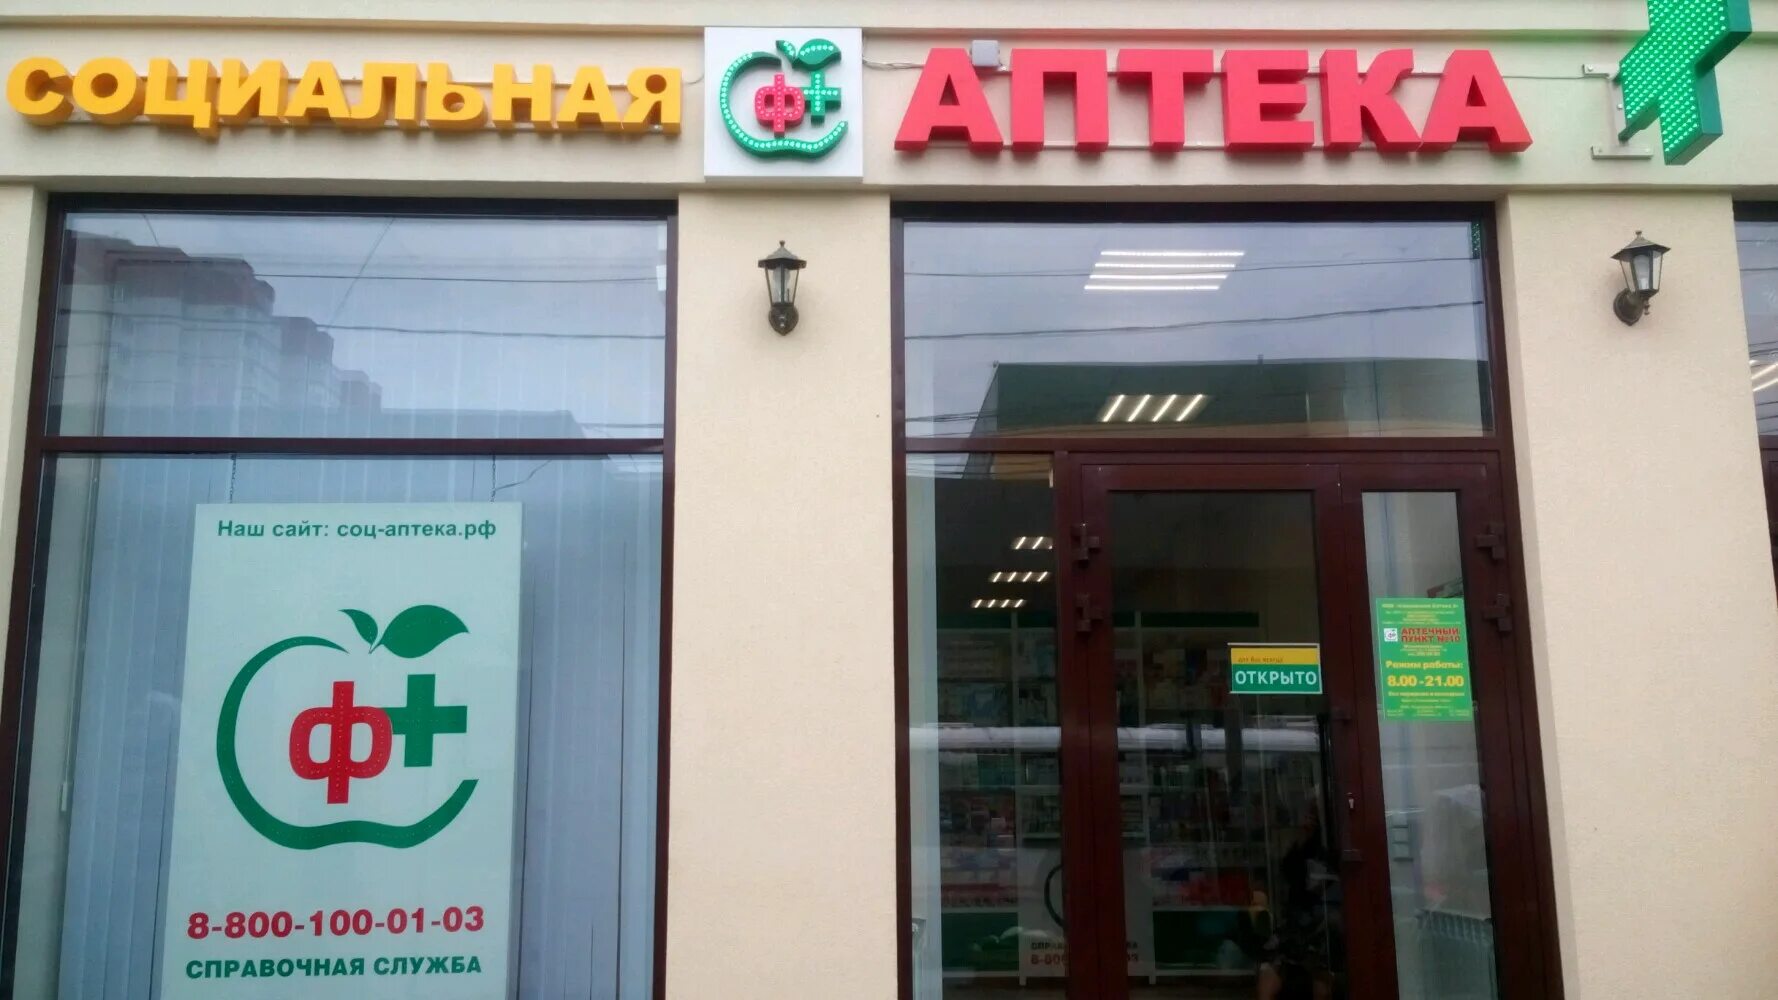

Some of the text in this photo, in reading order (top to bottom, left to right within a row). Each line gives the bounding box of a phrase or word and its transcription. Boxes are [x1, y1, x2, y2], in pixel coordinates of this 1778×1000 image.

[7, 57, 682, 138] СОЦИАЛЬНАЯ
[894, 48, 1533, 152] АПТЕКА
[217, 520, 497, 540] Наш сайт: соц-аптека.рф
[1401, 627, 1460, 635] АПТЕЧНЫЙ
[1385, 660, 1421, 669] Режим
[1235, 671, 1317, 685] ОТКРЫТО
[187, 906, 485, 939] 8-800-100-01-03
[186, 955, 483, 979] СПРАВОЧНАЯ СЛУЖБА
